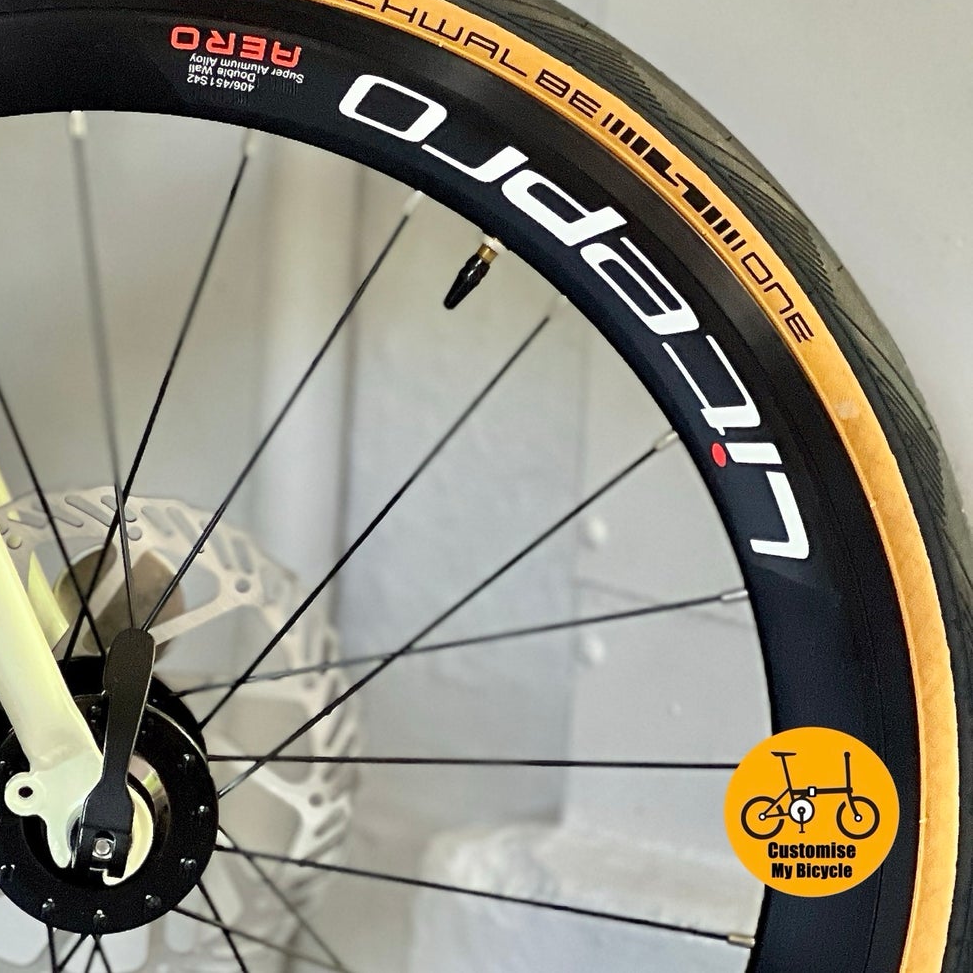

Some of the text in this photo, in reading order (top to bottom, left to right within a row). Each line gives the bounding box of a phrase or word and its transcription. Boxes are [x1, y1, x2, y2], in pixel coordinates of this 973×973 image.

[170, 26, 302, 68] AERO
[189, 52, 218, 67] Alloy
[186, 73, 255, 93] 406/451 S42
[188, 63, 256, 83] Double Wall
[271, 68, 305, 84] Super
[742, 251, 814, 343] ONE
